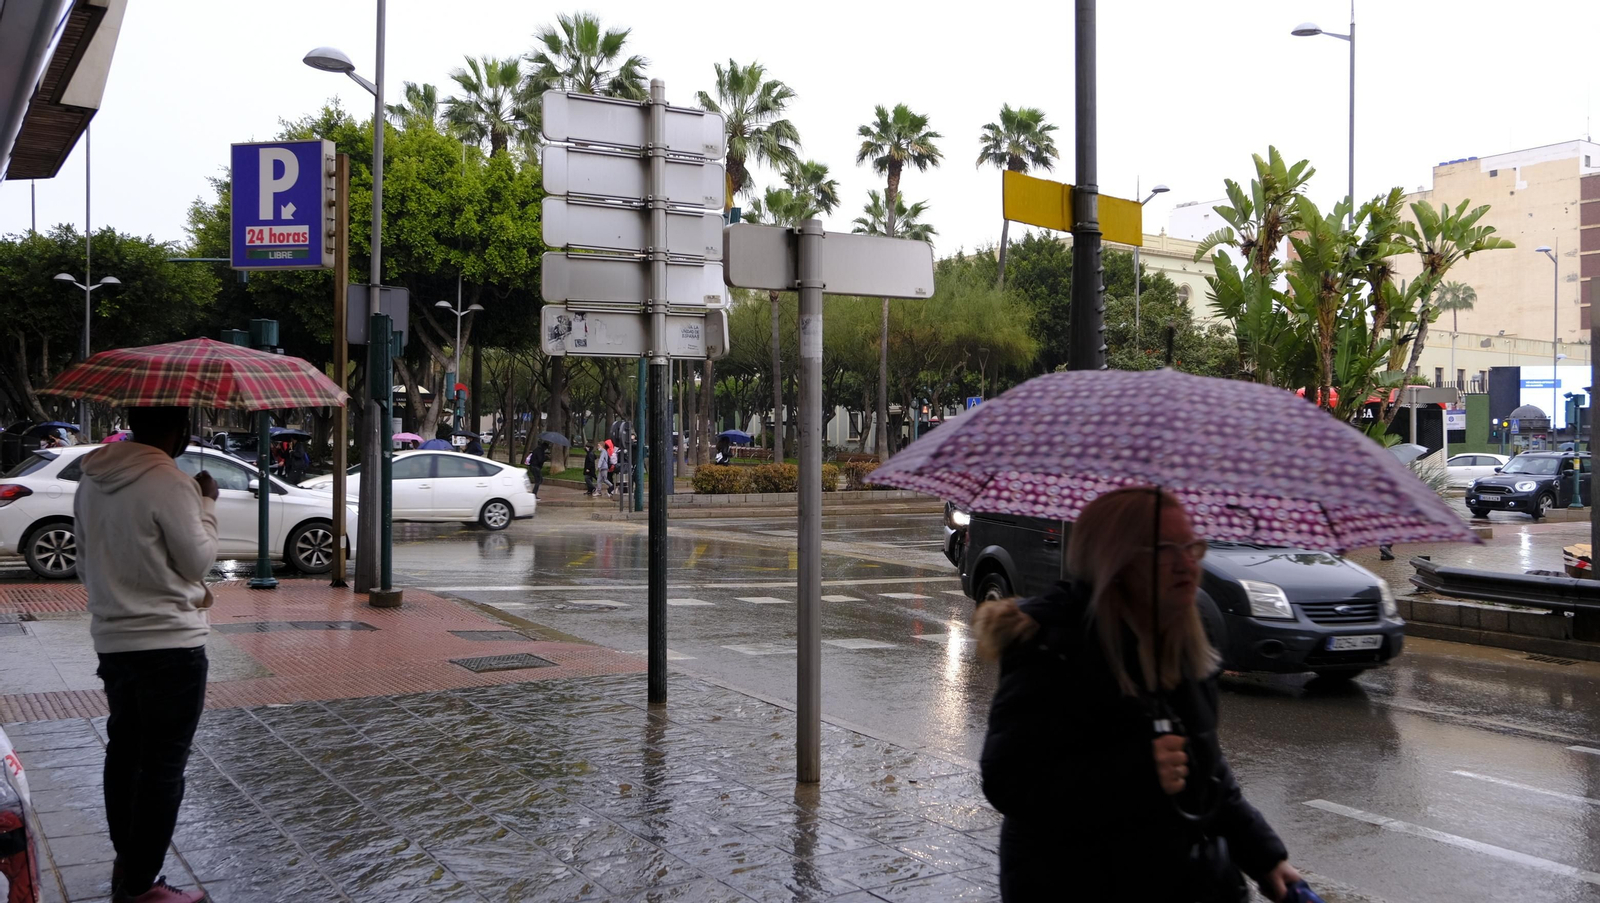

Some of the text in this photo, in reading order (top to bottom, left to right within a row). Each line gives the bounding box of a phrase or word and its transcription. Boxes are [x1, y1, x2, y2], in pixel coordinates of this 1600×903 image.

[259, 147, 299, 220] P
[247, 228, 308, 244] 24 horas
[268, 251, 293, 259] LIBRE
